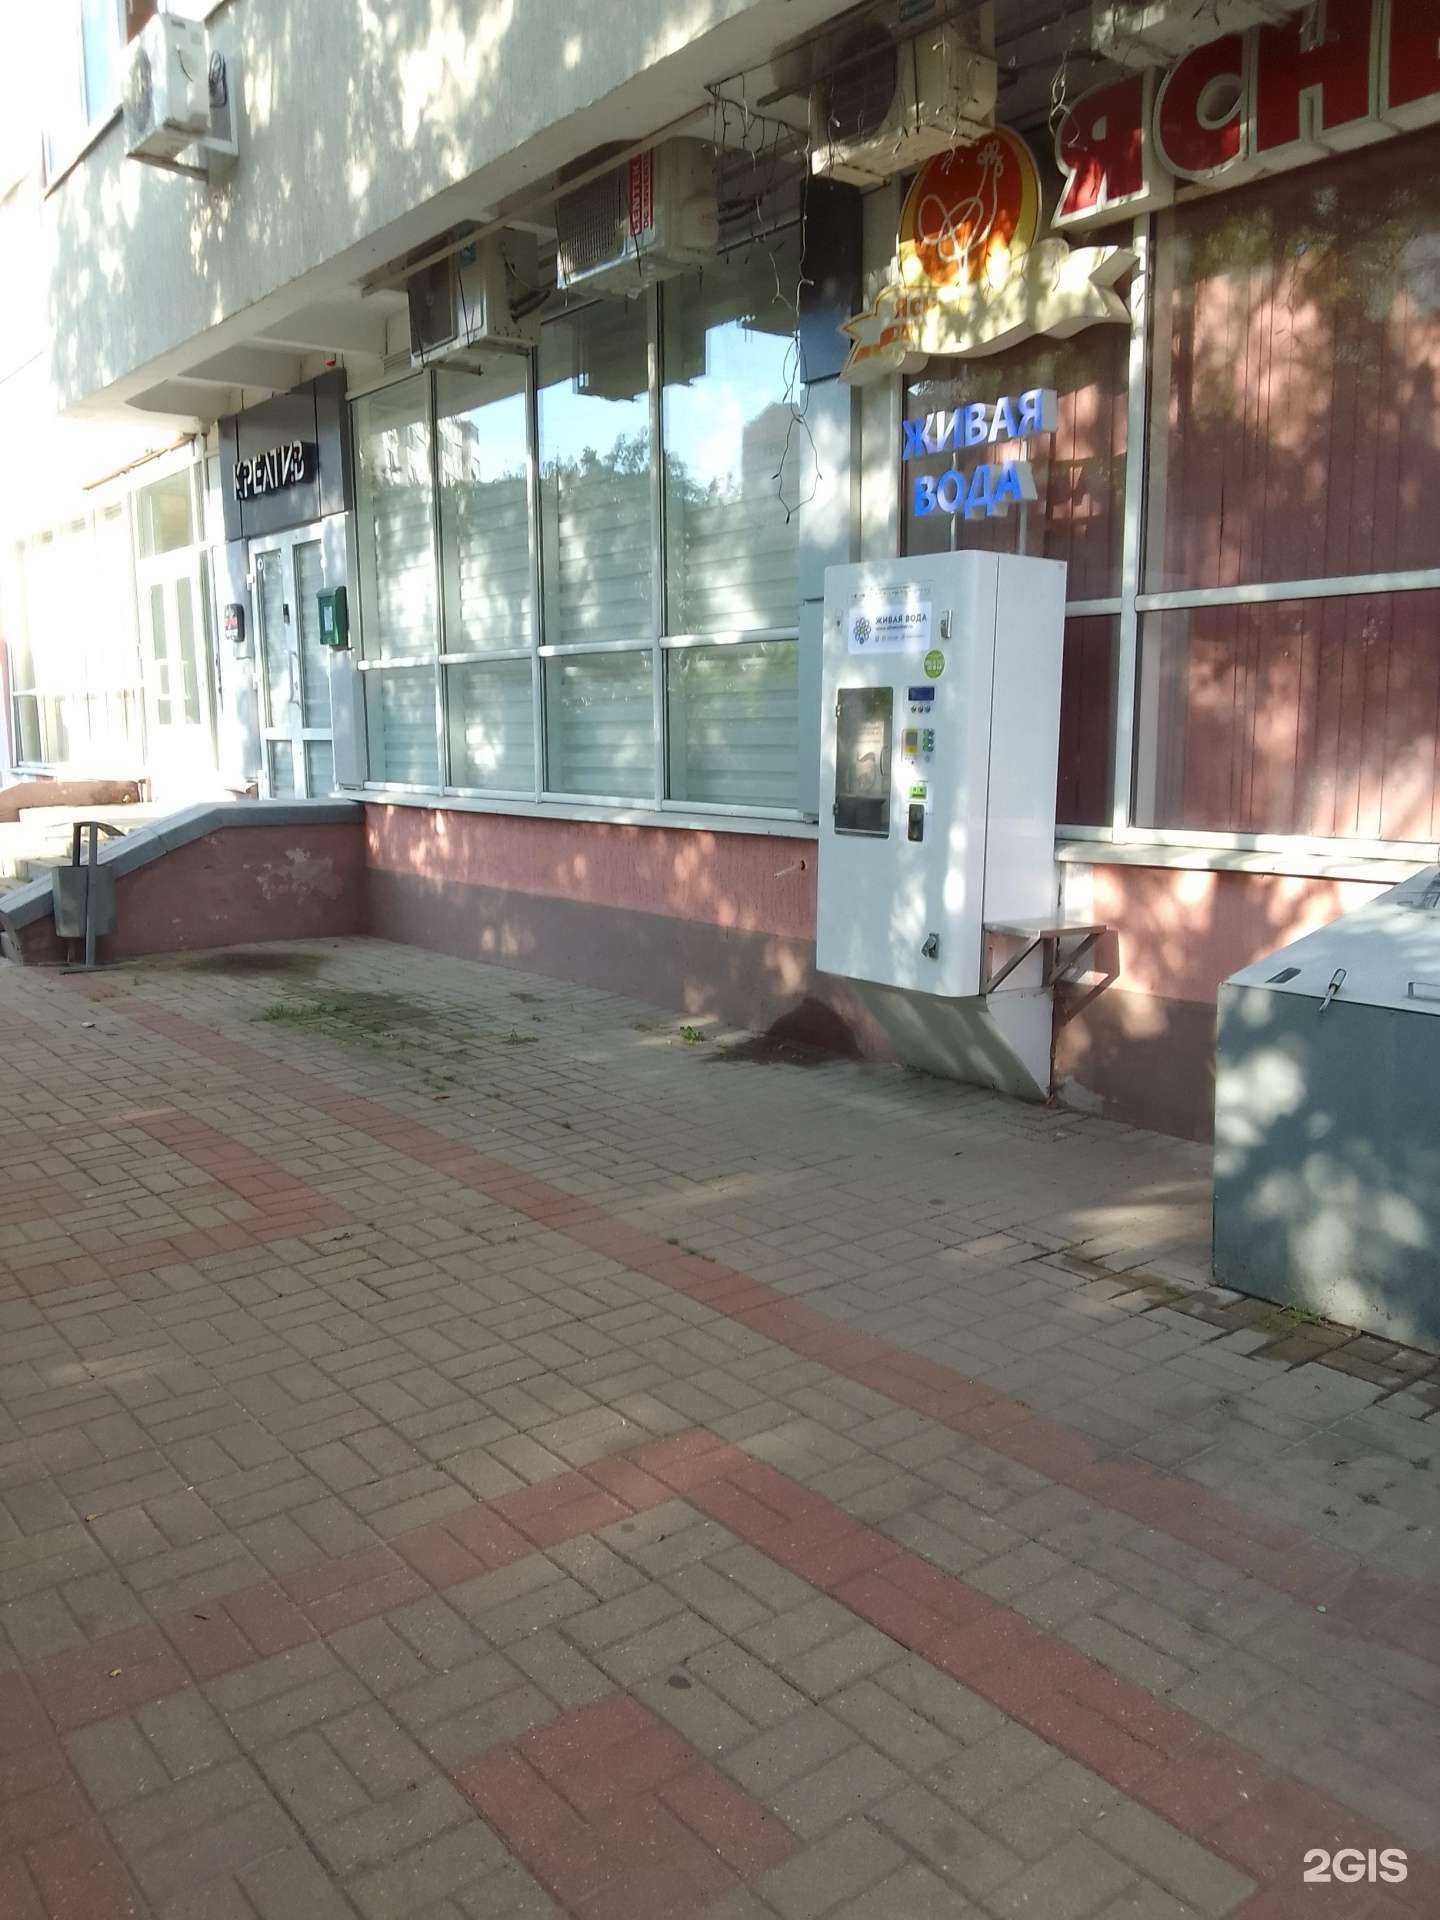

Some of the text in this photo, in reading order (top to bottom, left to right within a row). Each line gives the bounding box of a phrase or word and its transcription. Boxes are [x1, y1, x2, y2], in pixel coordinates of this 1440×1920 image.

[902, 388, 1043, 462] ЖИВАЯ
[914, 459, 1024, 521] ВОДА
[875, 613, 928, 625] ЖИВАЯ ВОДА
